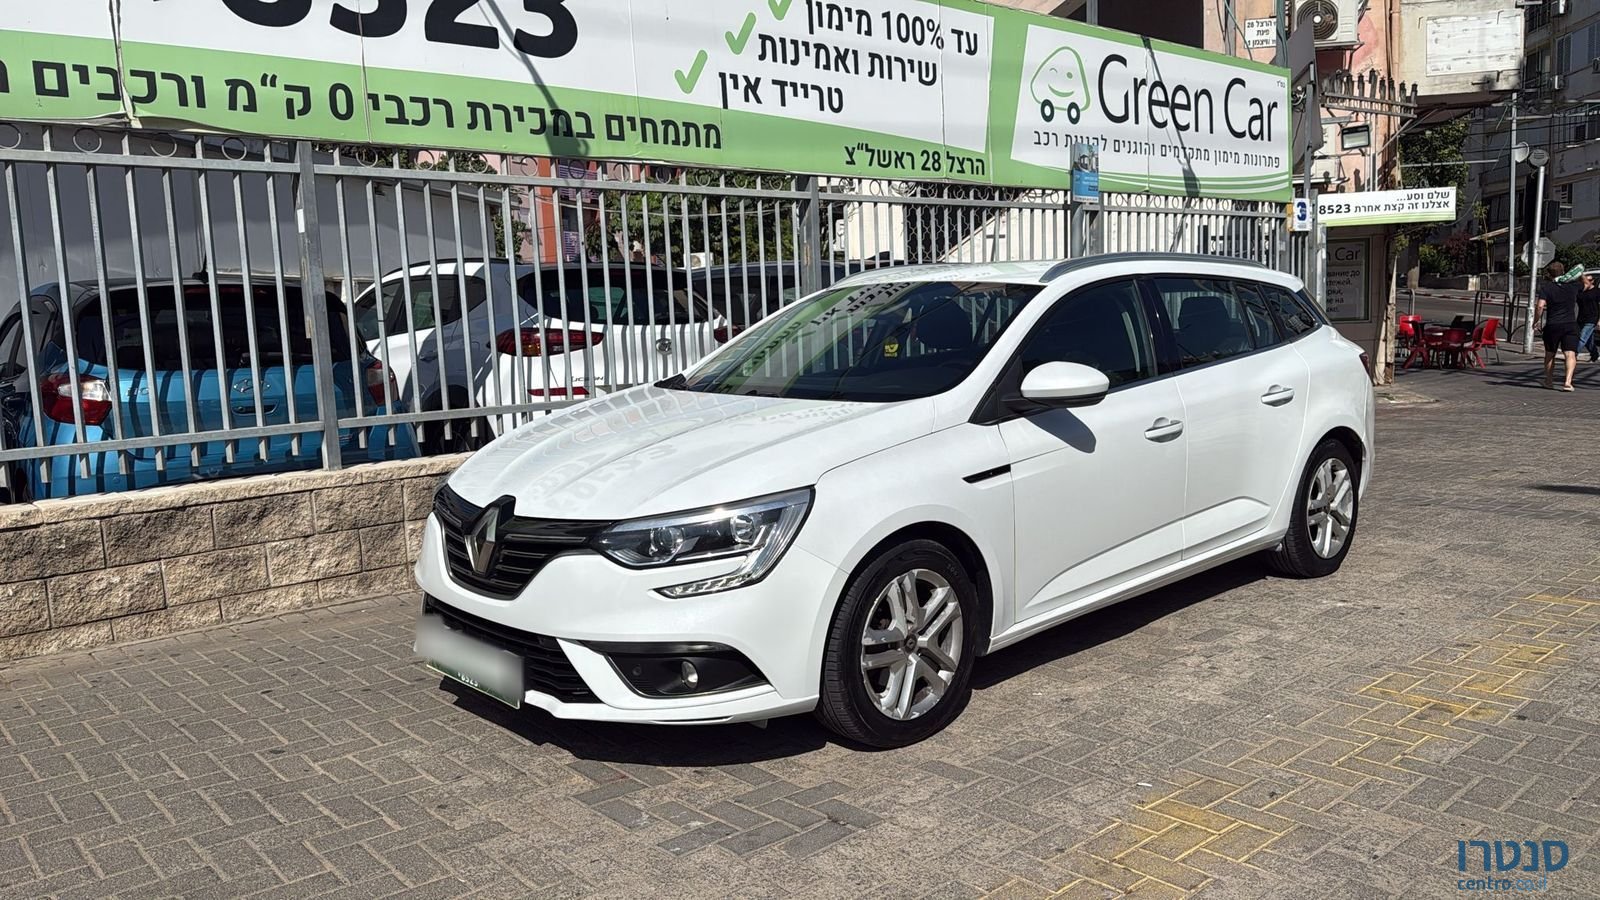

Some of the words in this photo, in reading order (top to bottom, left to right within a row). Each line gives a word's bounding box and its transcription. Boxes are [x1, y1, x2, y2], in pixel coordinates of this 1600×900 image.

[805, 0, 873, 36] מימון
[881, 11, 945, 50] 100%
[950, 28, 979, 56] עד
[757, 33, 860, 75] ואמינות
[867, 52, 937, 87] שירות
[32, 60, 207, 109] ורכבים
[718, 71, 762, 110] אין
[771, 79, 844, 114] טרייד
[1098, 54, 1215, 135] Green
[1223, 78, 1278, 142] Car
[367, 93, 455, 129] רכבי
[466, 101, 596, 139] במכירת
[605, 114, 721, 150] מתמחים
[1033, 130, 1059, 147] רכב
[1113, 139, 1155, 157] והוגנים
[1160, 144, 1210, 165] מתקדמים
[1214, 149, 1240, 166] מימון
[920, 149, 942, 172] 28
[946, 150, 985, 175] הרצל
[1243, 152, 1280, 169] פתרונות
[1407, 201, 1419, 210] זה
[1421, 200, 1450, 209] אצלנו
[1427, 190, 1450, 200] שלם
[1318, 203, 1351, 215] 8523
[1354, 204, 1381, 213] אחרת
[1383, 202, 1405, 213] קצת
[1335, 247, 1361, 261] Car
